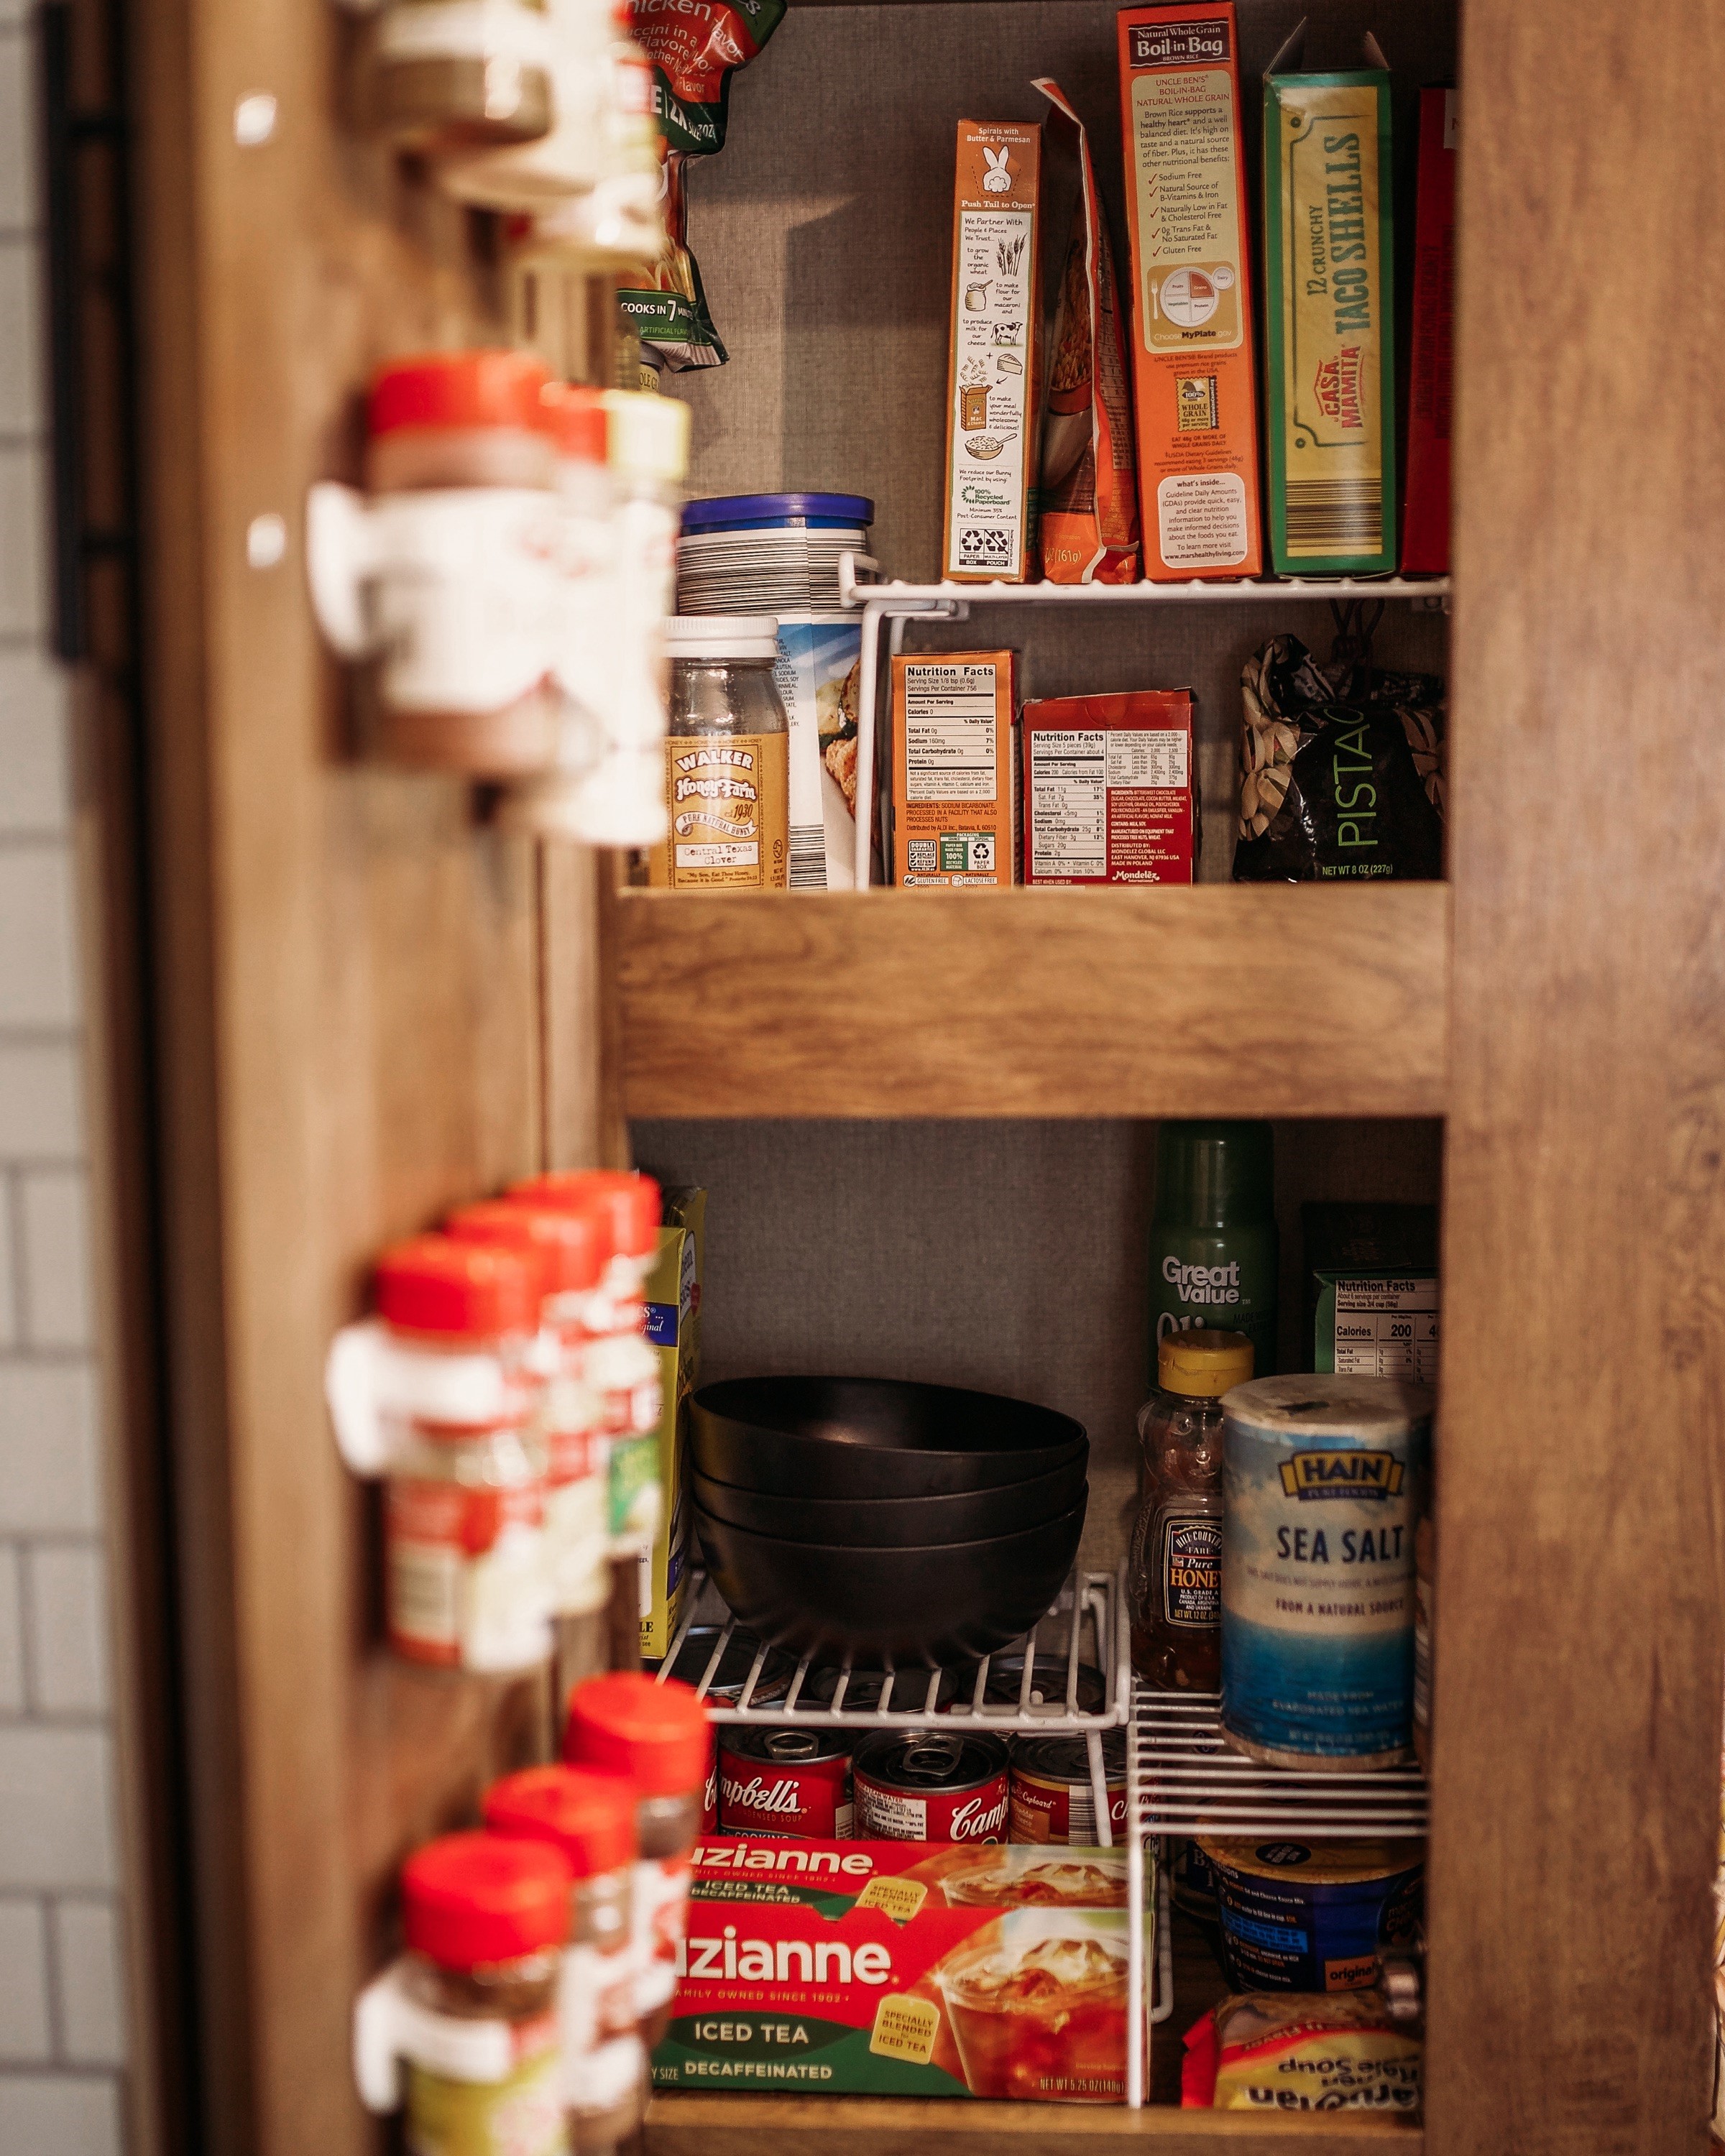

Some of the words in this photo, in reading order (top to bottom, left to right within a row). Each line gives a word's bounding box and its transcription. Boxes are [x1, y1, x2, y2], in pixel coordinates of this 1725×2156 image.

[1138, 29, 1169, 39] Natural
[1169, 27, 1195, 36] Whole
[1137, 97, 1172, 106] NATURAL
[1163, 156, 1199, 166] nutritional
[1200, 155, 1230, 163] benefits:
[1160, 192, 1196, 201] B-Vitamins
[1324, 133, 1366, 263] SHELLS
[1161, 205, 1192, 214] Naturally
[1168, 211, 1206, 221] Cholesterol
[1309, 206, 1325, 275] CRUNCHY
[1307, 277, 1328, 295] 12
[1333, 267, 1371, 335] TACO
[621, 303, 655, 314] COOKS
[657, 305, 666, 314] IN
[667, 300, 676, 321] 7
[1321, 361, 1340, 415] CASA
[1341, 346, 1363, 428] MAMITA
[964, 667, 993, 676] Facts
[676, 750, 753, 772] WALKER
[676, 778, 719, 801] Honey
[719, 778, 756, 800] Farm
[734, 803, 753, 821] 1930
[683, 814, 700, 823] PURE
[703, 815, 730, 831] NATURAL
[731, 826, 750, 835] HONEY
[684, 846, 722, 856] Central
[726, 844, 753, 853] Texas
[704, 856, 737, 865] Clover
[1322, 867, 1338, 875] NET
[1339, 866, 1350, 875] WT
[1352, 866, 1356, 875] 8
[1358, 865, 1369, 875] OZ
[1371, 865, 1393, 875] (227g)
[1162, 1256, 1241, 1287] Great
[1177, 1284, 1241, 1304] Value
[1338, 1281, 1384, 1291] Nutrition
[1386, 1281, 1415, 1291] Facts
[1337, 1326, 1371, 1336] Calories
[1391, 1324, 1412, 1337] 200
[1302, 1457, 1383, 1482] HAIN
[1276, 1525, 1330, 1563] SEA
[1342, 1526, 1404, 1564] SALT
[1186, 1558, 1213, 1569] Pure
[1170, 1567, 1221, 1588] HONE
[1307, 1603, 1313, 1615] A
[1317, 1601, 1365, 1616] NATURAL
[705, 1880, 748, 1892] ICED
[755, 1882, 789, 1895] TEA
[717, 1990, 764, 2001] OWNED
[770, 1991, 806, 2002] SINCE
[884, 2010, 934, 2027] SPECIALLY
[695, 2021, 753, 2042] ICED
[760, 2023, 809, 2044] TEA
[882, 2019, 932, 2037] BLENDED
[878, 2034, 903, 2049] ICED
[907, 2040, 927, 2054] TEA
[685, 2060, 833, 2080] DECAFFEINATED
[1279, 2058, 1353, 2076] Soup
